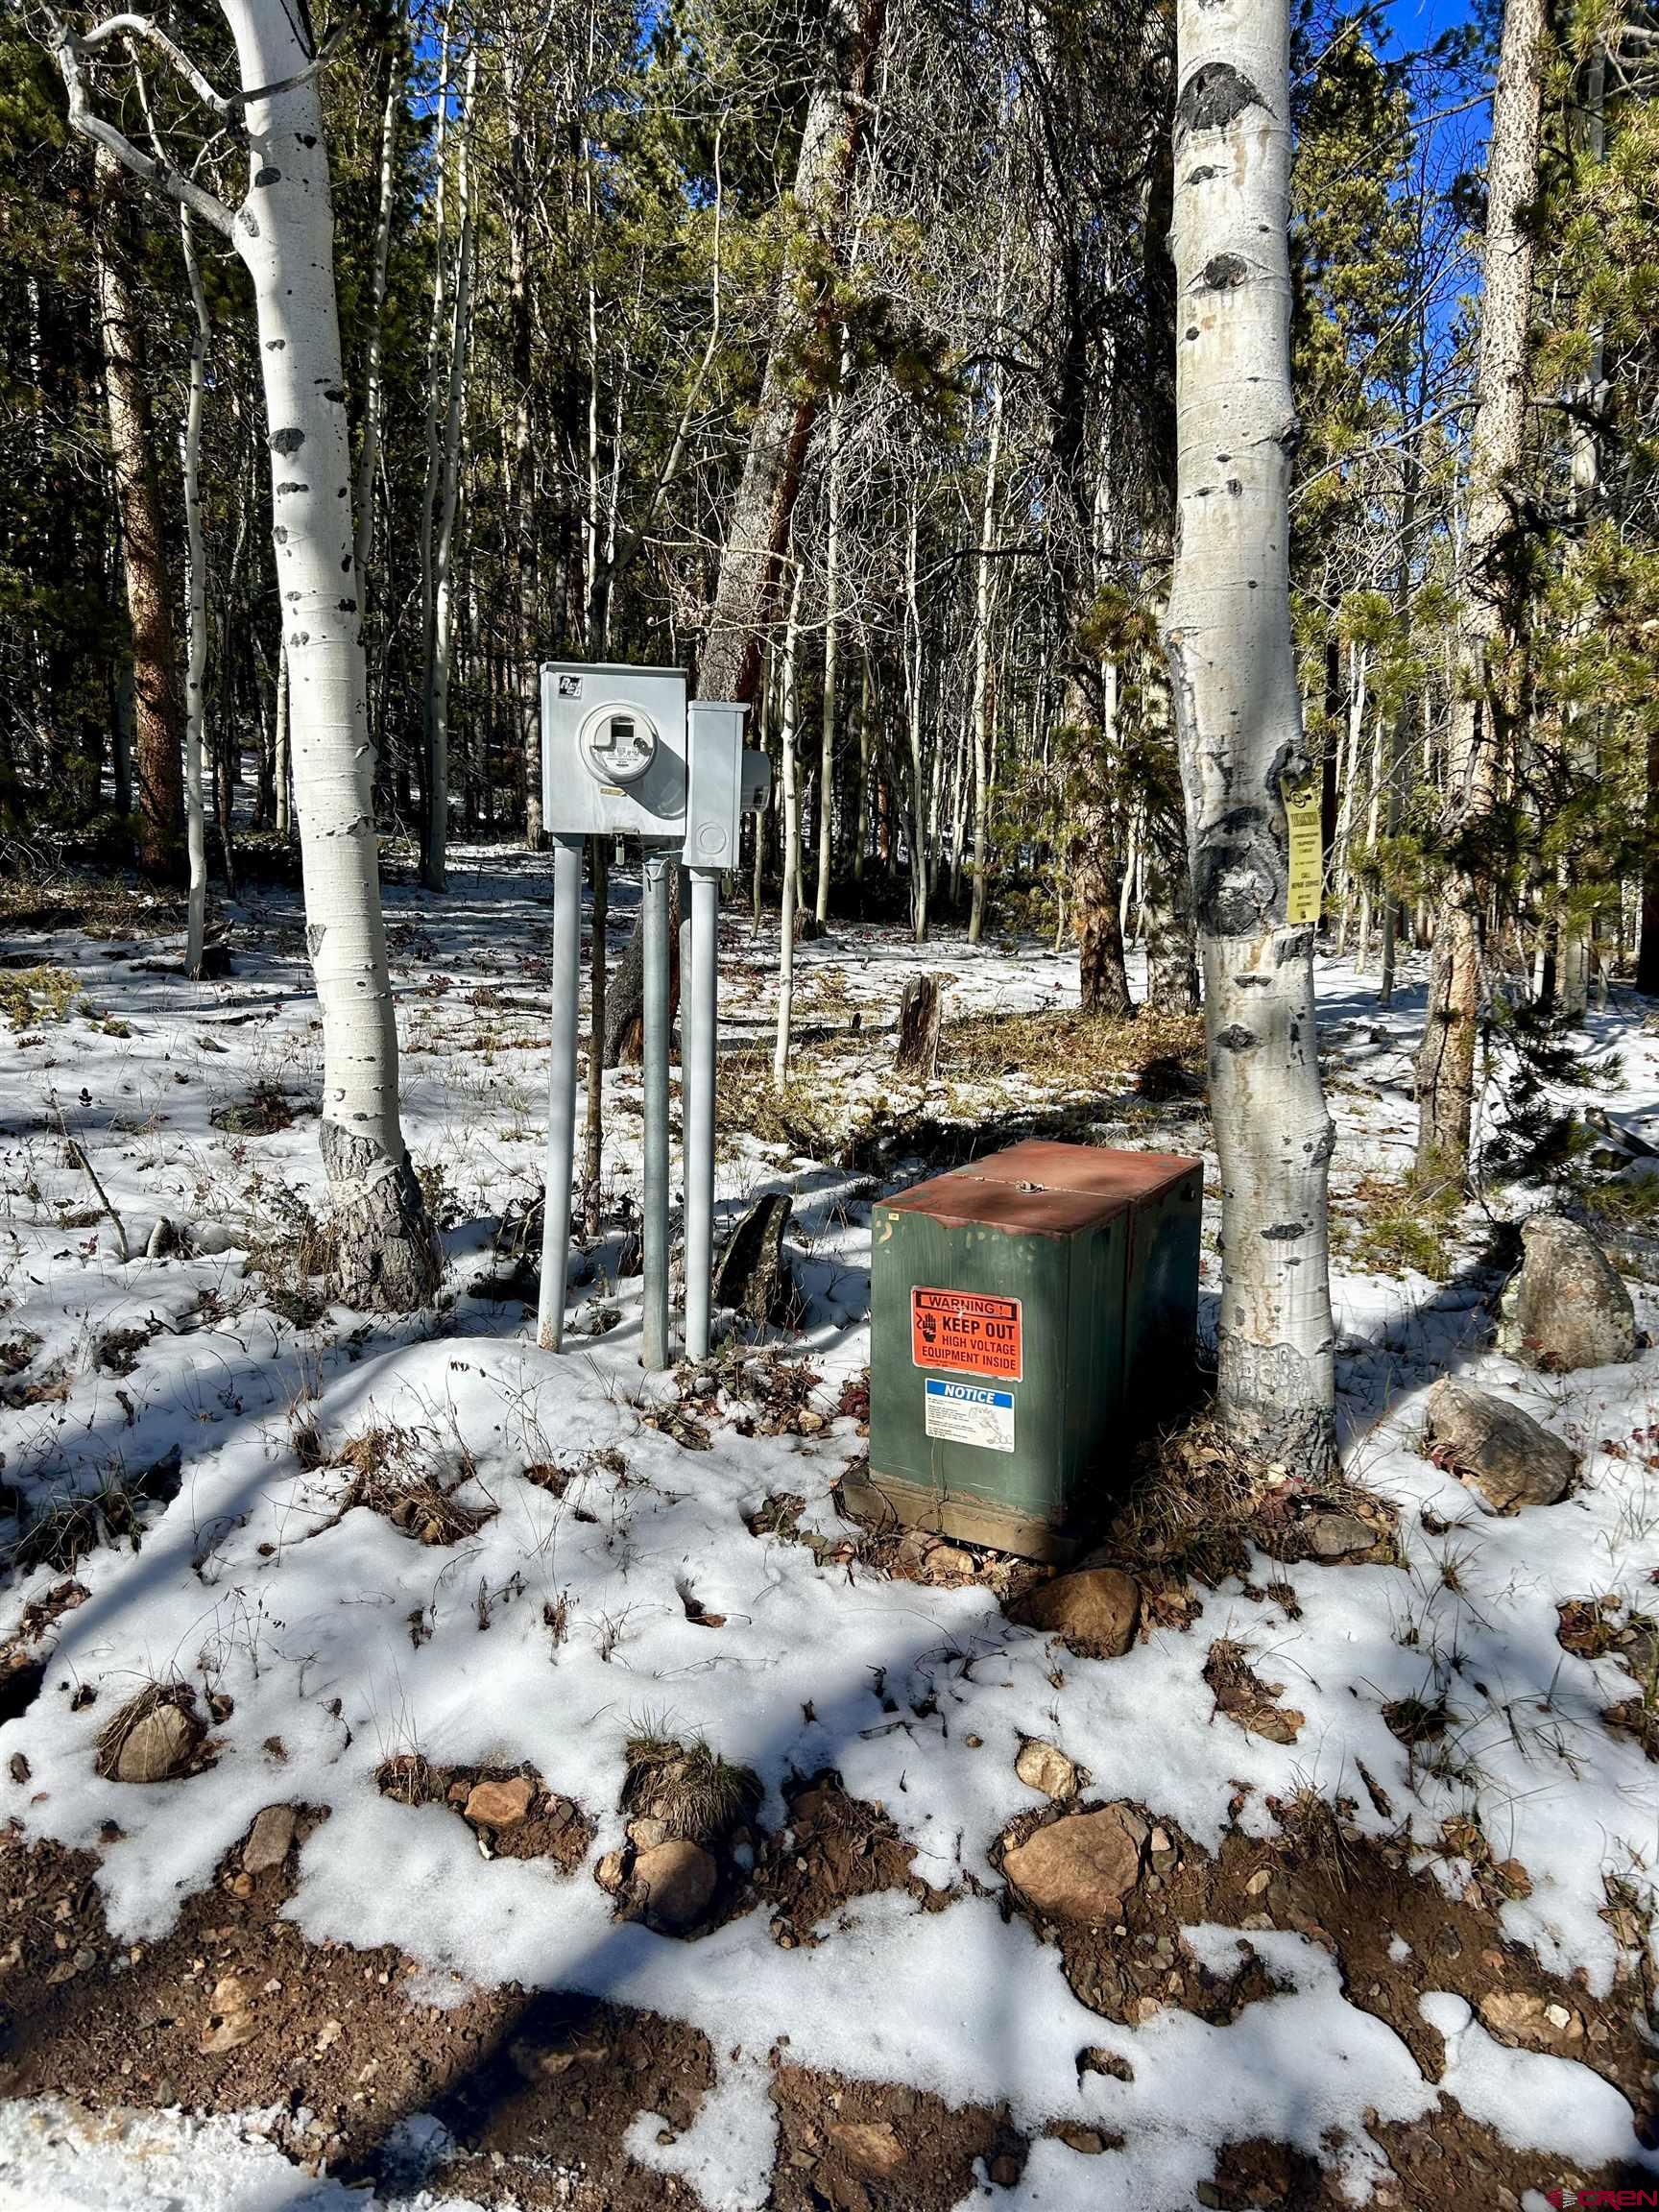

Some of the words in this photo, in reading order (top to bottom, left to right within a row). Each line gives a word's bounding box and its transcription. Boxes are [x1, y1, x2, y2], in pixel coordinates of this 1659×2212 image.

[943, 1316, 980, 1334] KEEP
[986, 1323, 1015, 1340] OUT
[942, 1334, 967, 1348] HIGH
[970, 1339, 1016, 1356] VOLTAGE
[922, 1346, 978, 1364] EQUIPMENT
[983, 1355, 1016, 1370] INSIDE
[945, 1384, 995, 1404] NOTICE
